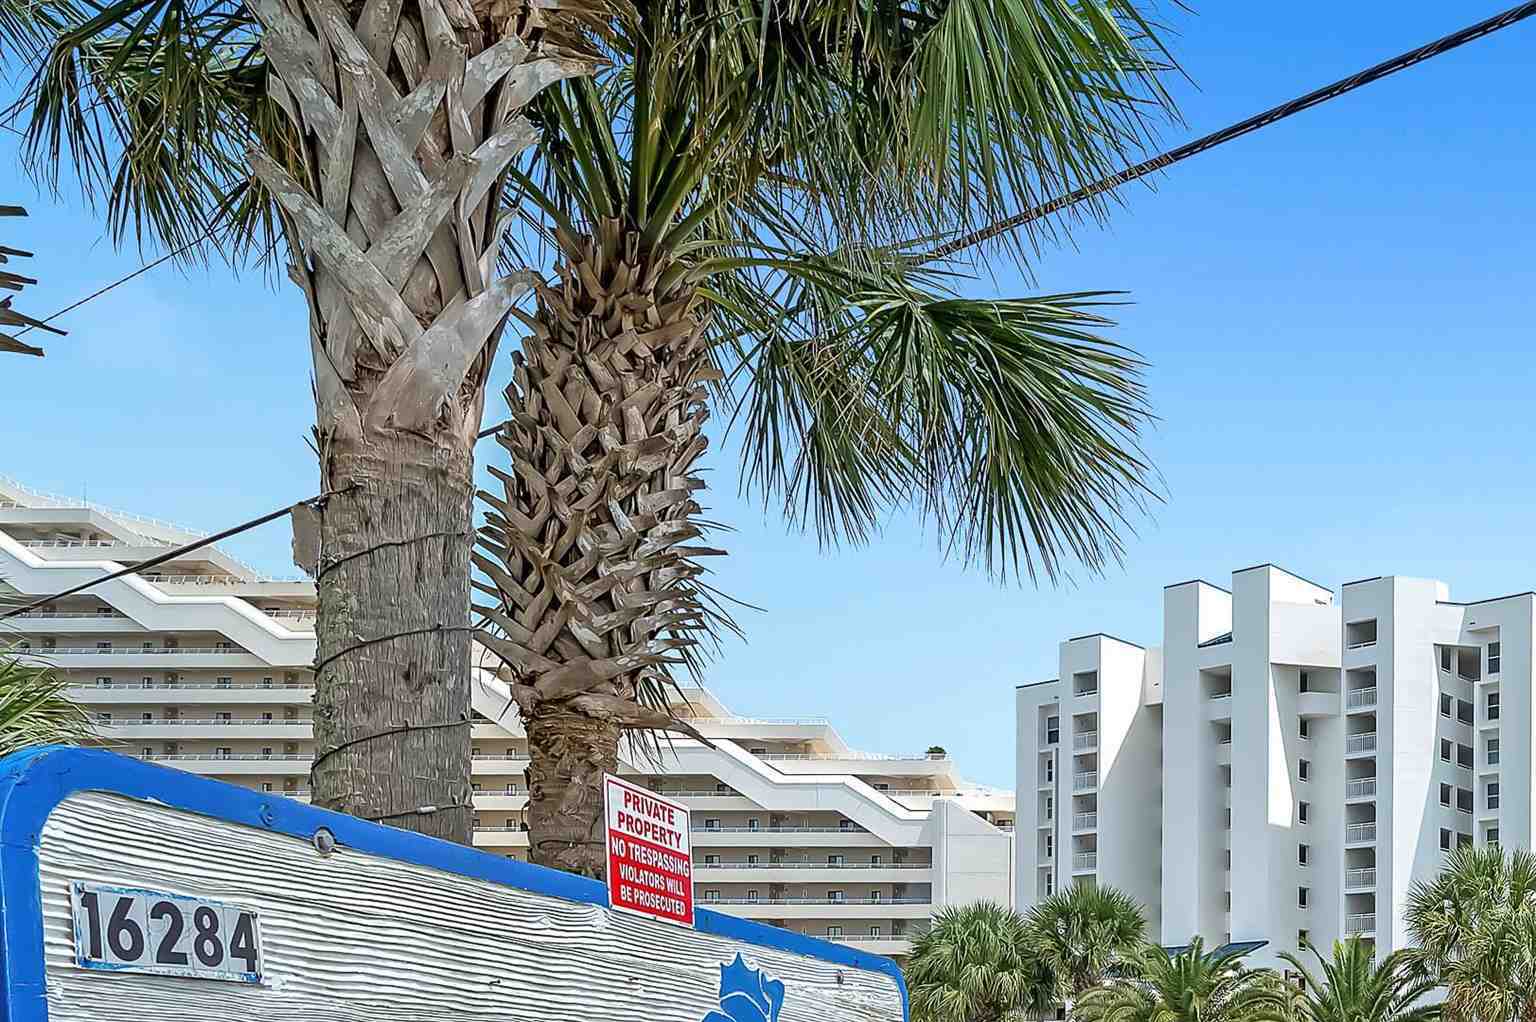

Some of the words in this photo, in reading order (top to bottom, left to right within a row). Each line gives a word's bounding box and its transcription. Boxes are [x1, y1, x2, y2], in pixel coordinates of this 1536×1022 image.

[623, 790, 675, 826] PRIVATE
[617, 811, 682, 849] PROPERTY
[611, 836, 626, 858] NO
[628, 842, 690, 878] TRESPASSING
[619, 863, 665, 891] VIOLATORS
[666, 879, 685, 897] WILL
[620, 884, 632, 901] BE
[634, 888, 686, 916] PROSECUTED
[80, 891, 258, 972] 16284
